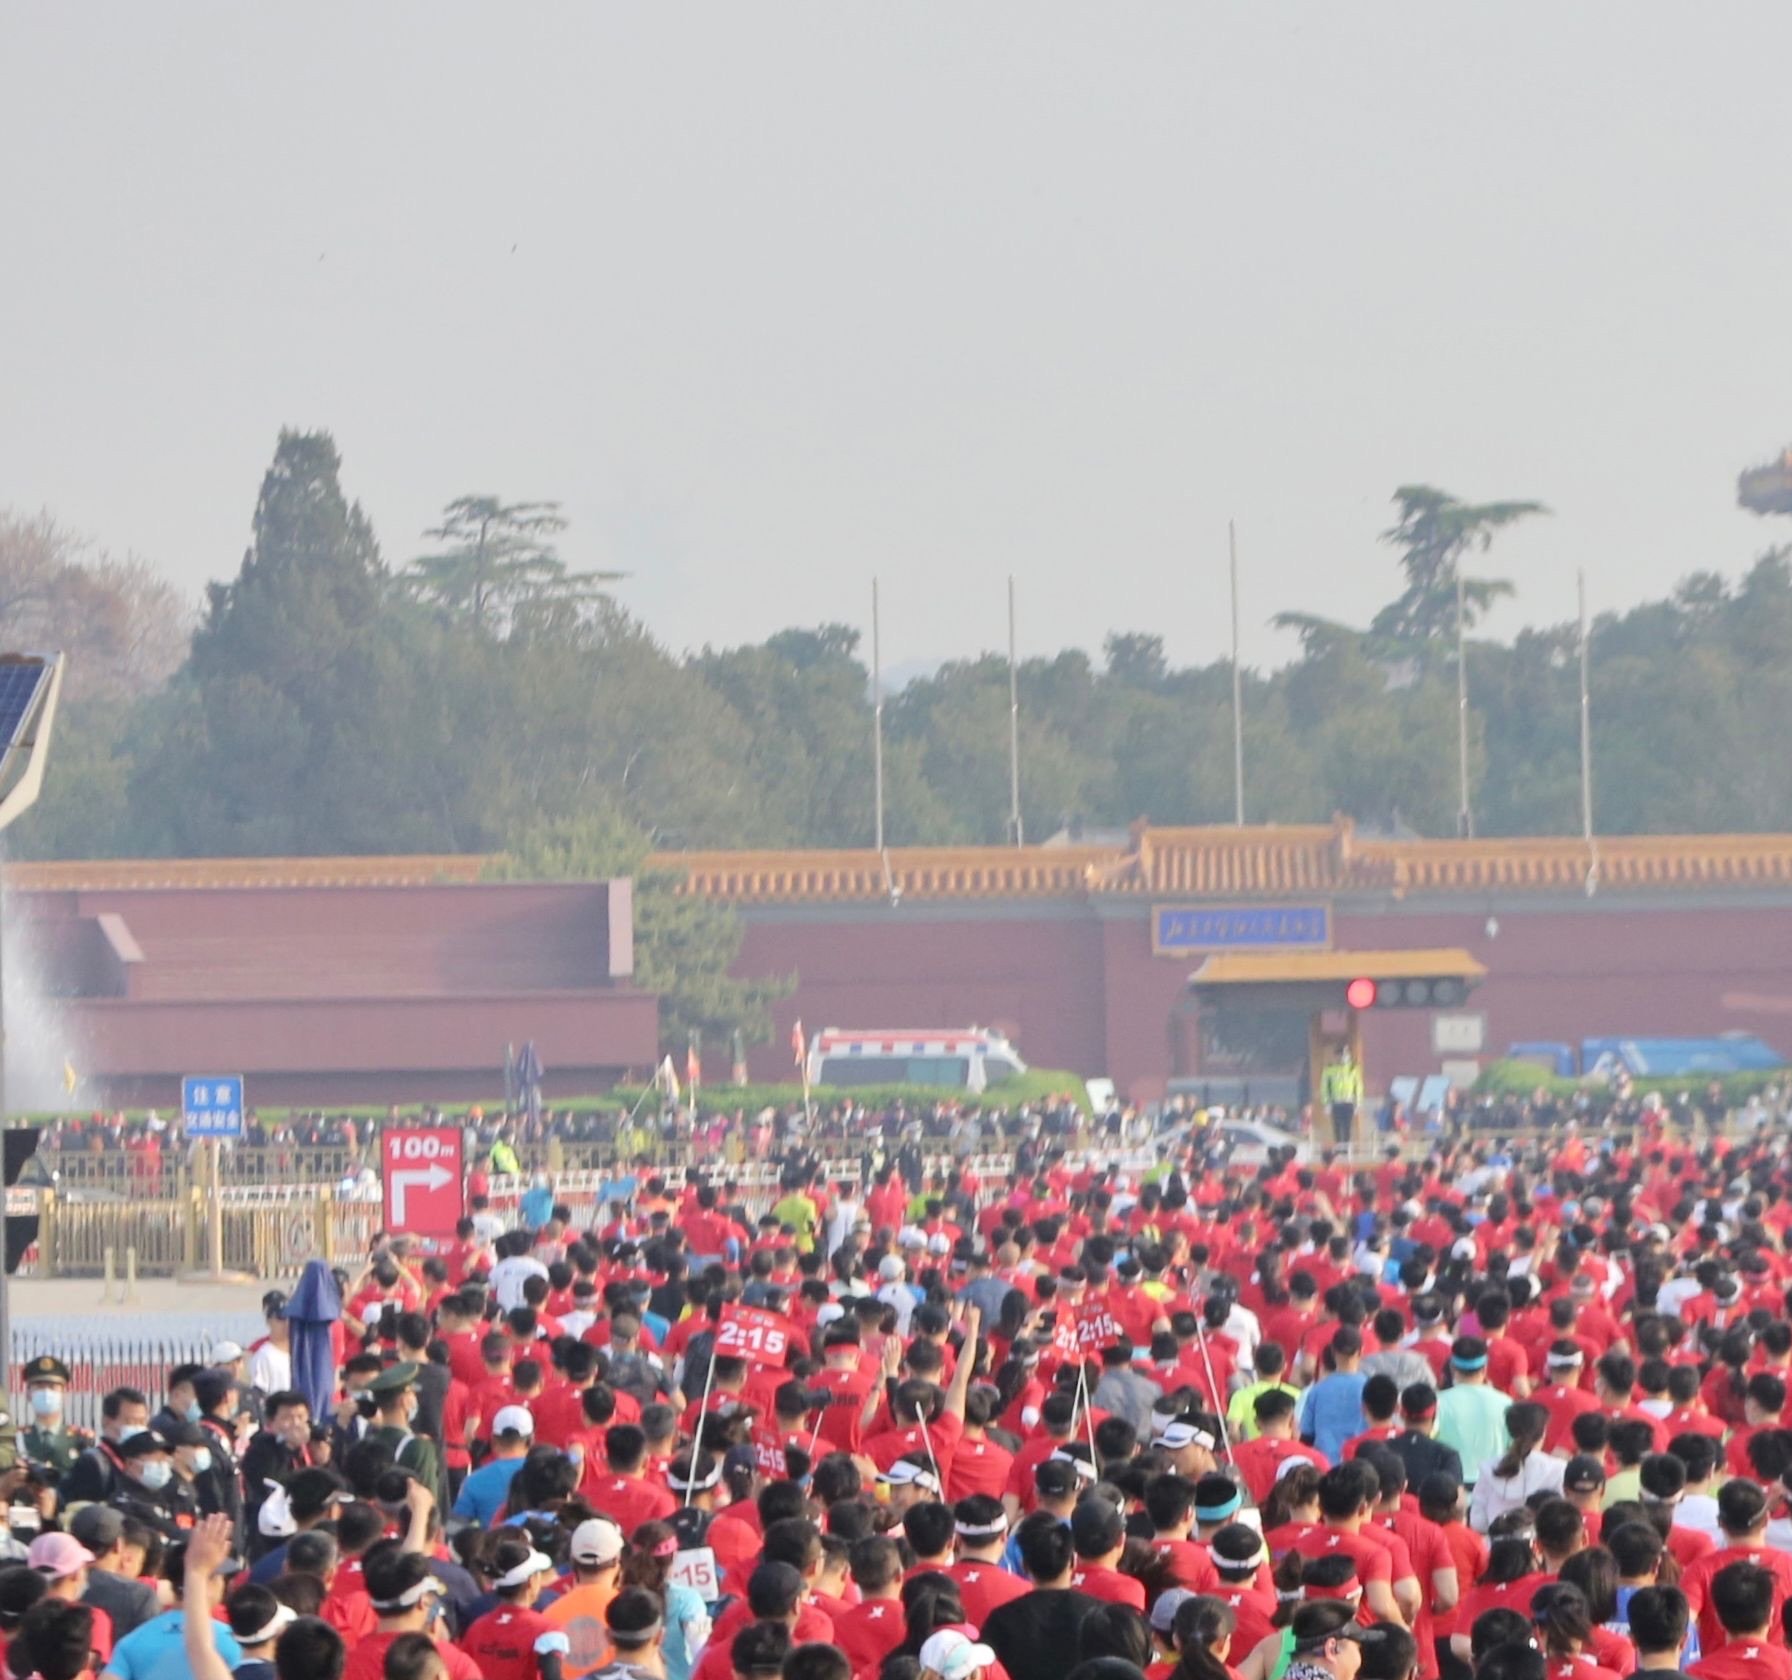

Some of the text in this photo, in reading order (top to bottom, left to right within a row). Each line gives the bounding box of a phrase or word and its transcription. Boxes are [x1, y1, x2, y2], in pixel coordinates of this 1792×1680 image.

[389, 1136, 455, 1160] 100m
[719, 1321, 785, 1354] 2:15
[1077, 1313, 1114, 1344] 2:15
[756, 1442, 785, 1472] 2:15
